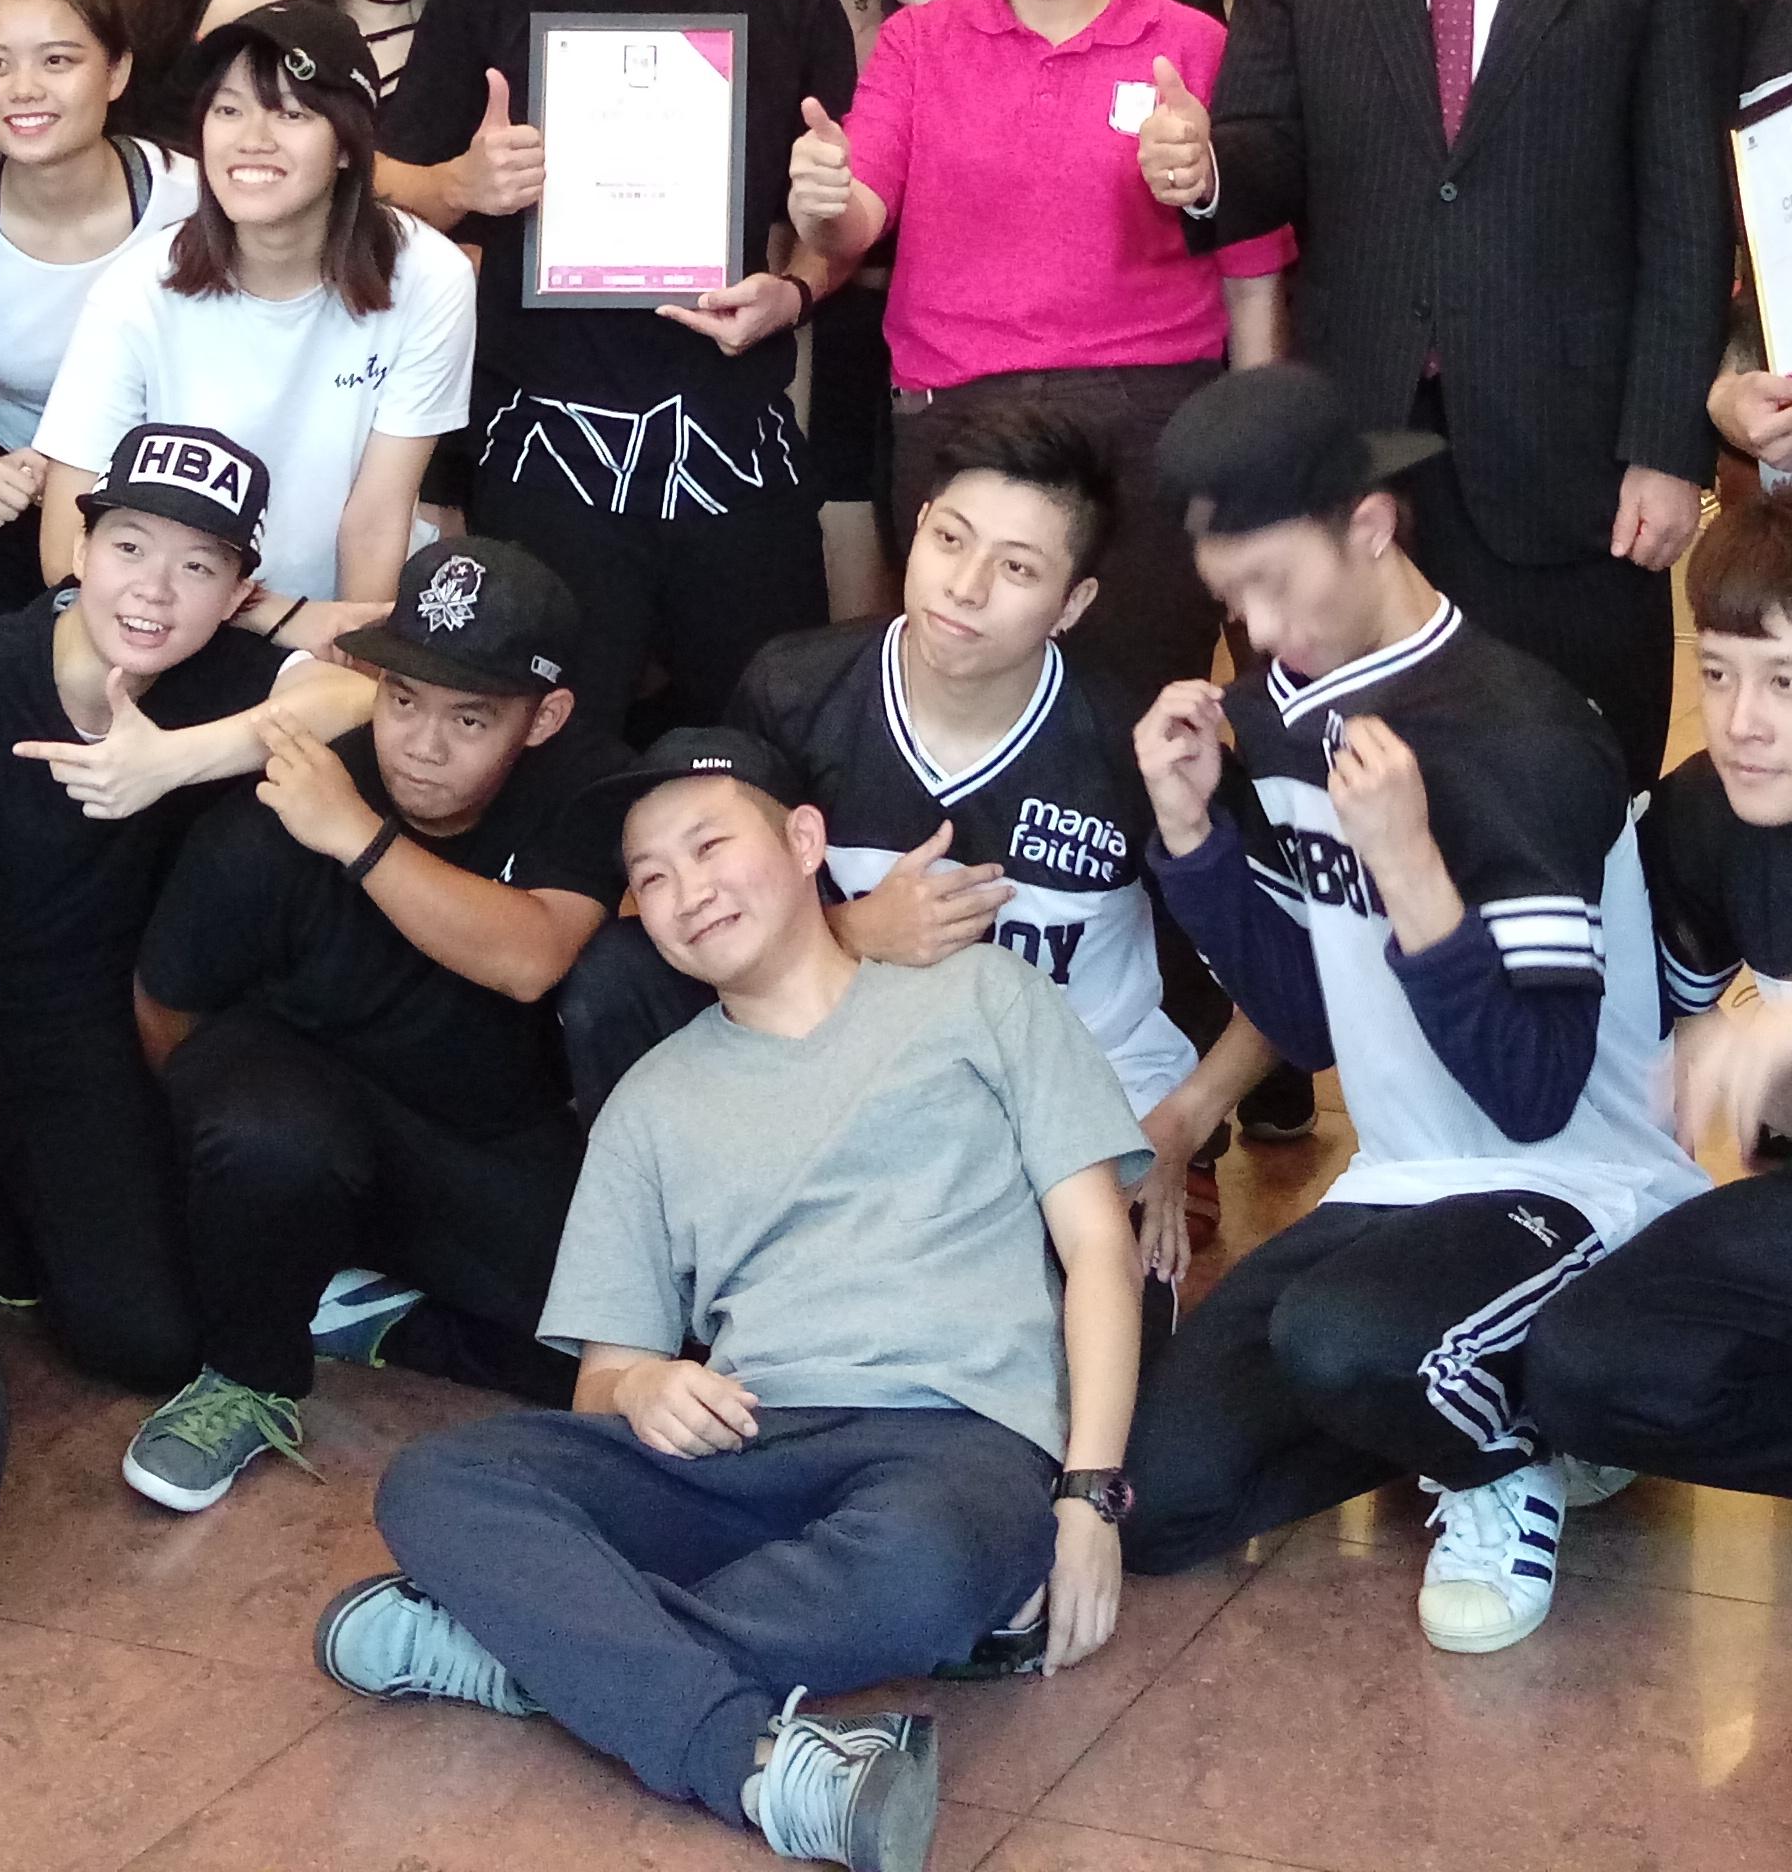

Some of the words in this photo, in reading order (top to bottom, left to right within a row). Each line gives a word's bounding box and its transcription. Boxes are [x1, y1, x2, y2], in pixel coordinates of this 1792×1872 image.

[138, 441, 239, 503] HBA
[693, 758, 732, 769] MINI
[1019, 797, 1127, 857] mania
